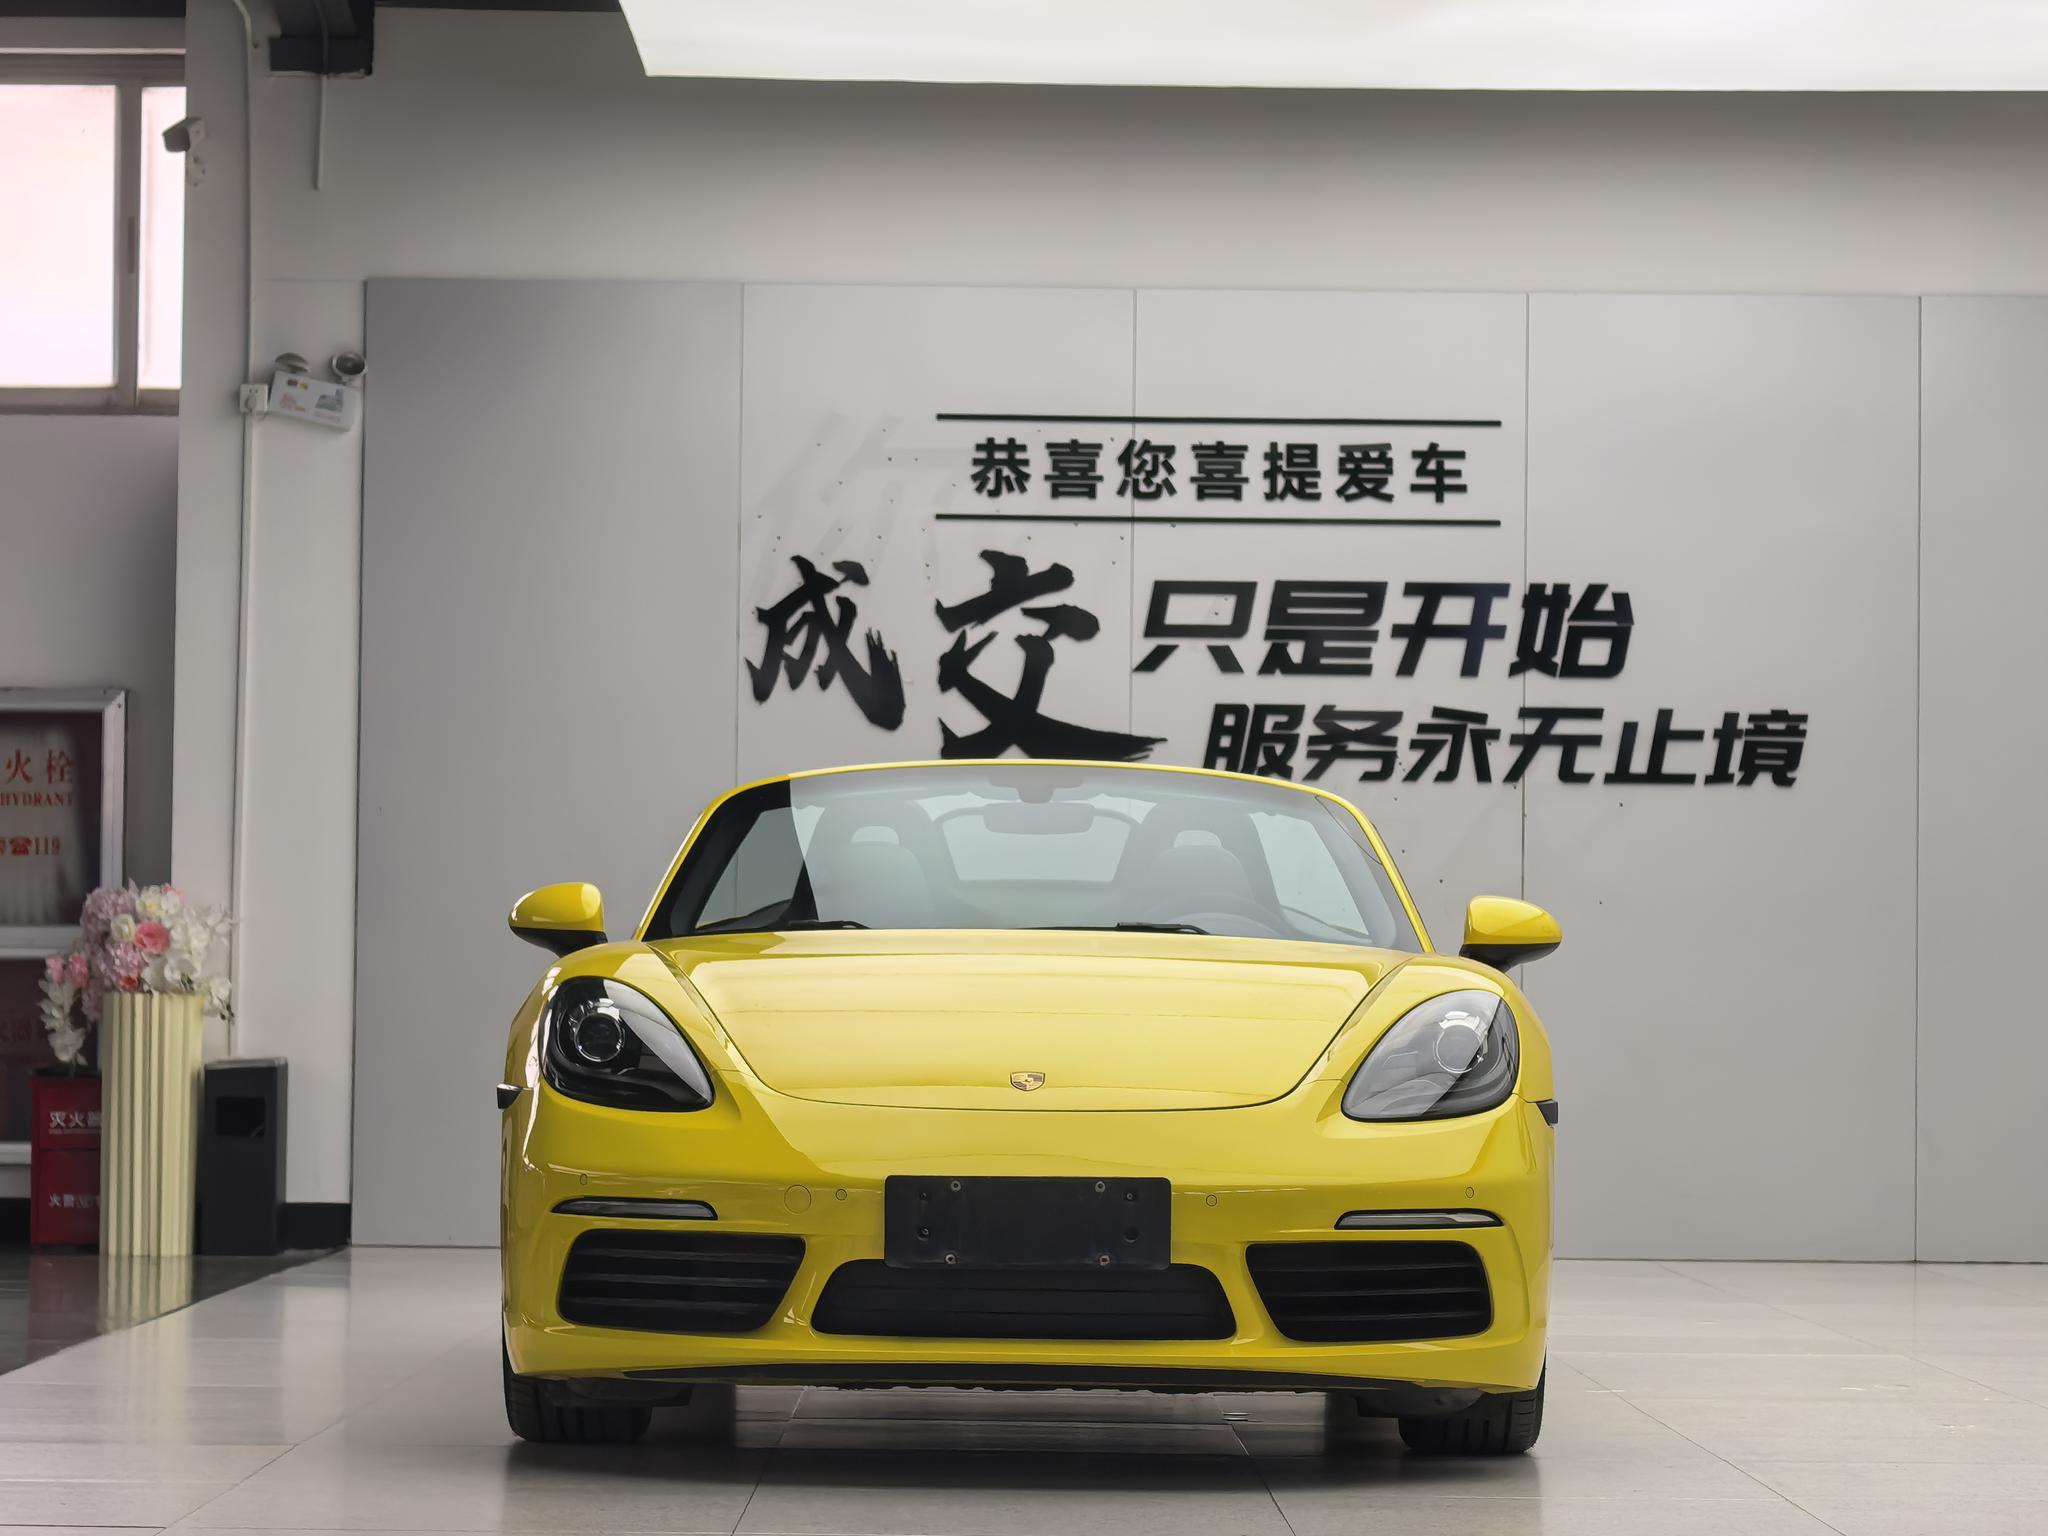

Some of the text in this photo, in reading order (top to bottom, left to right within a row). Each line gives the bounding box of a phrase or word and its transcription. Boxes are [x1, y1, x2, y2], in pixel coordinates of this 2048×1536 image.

[971, 438, 1468, 504] 恭喜您喜提爱车
[745, 549, 1635, 760] 成交 只是开始
[1203, 703, 1809, 787] 服务永无止境
